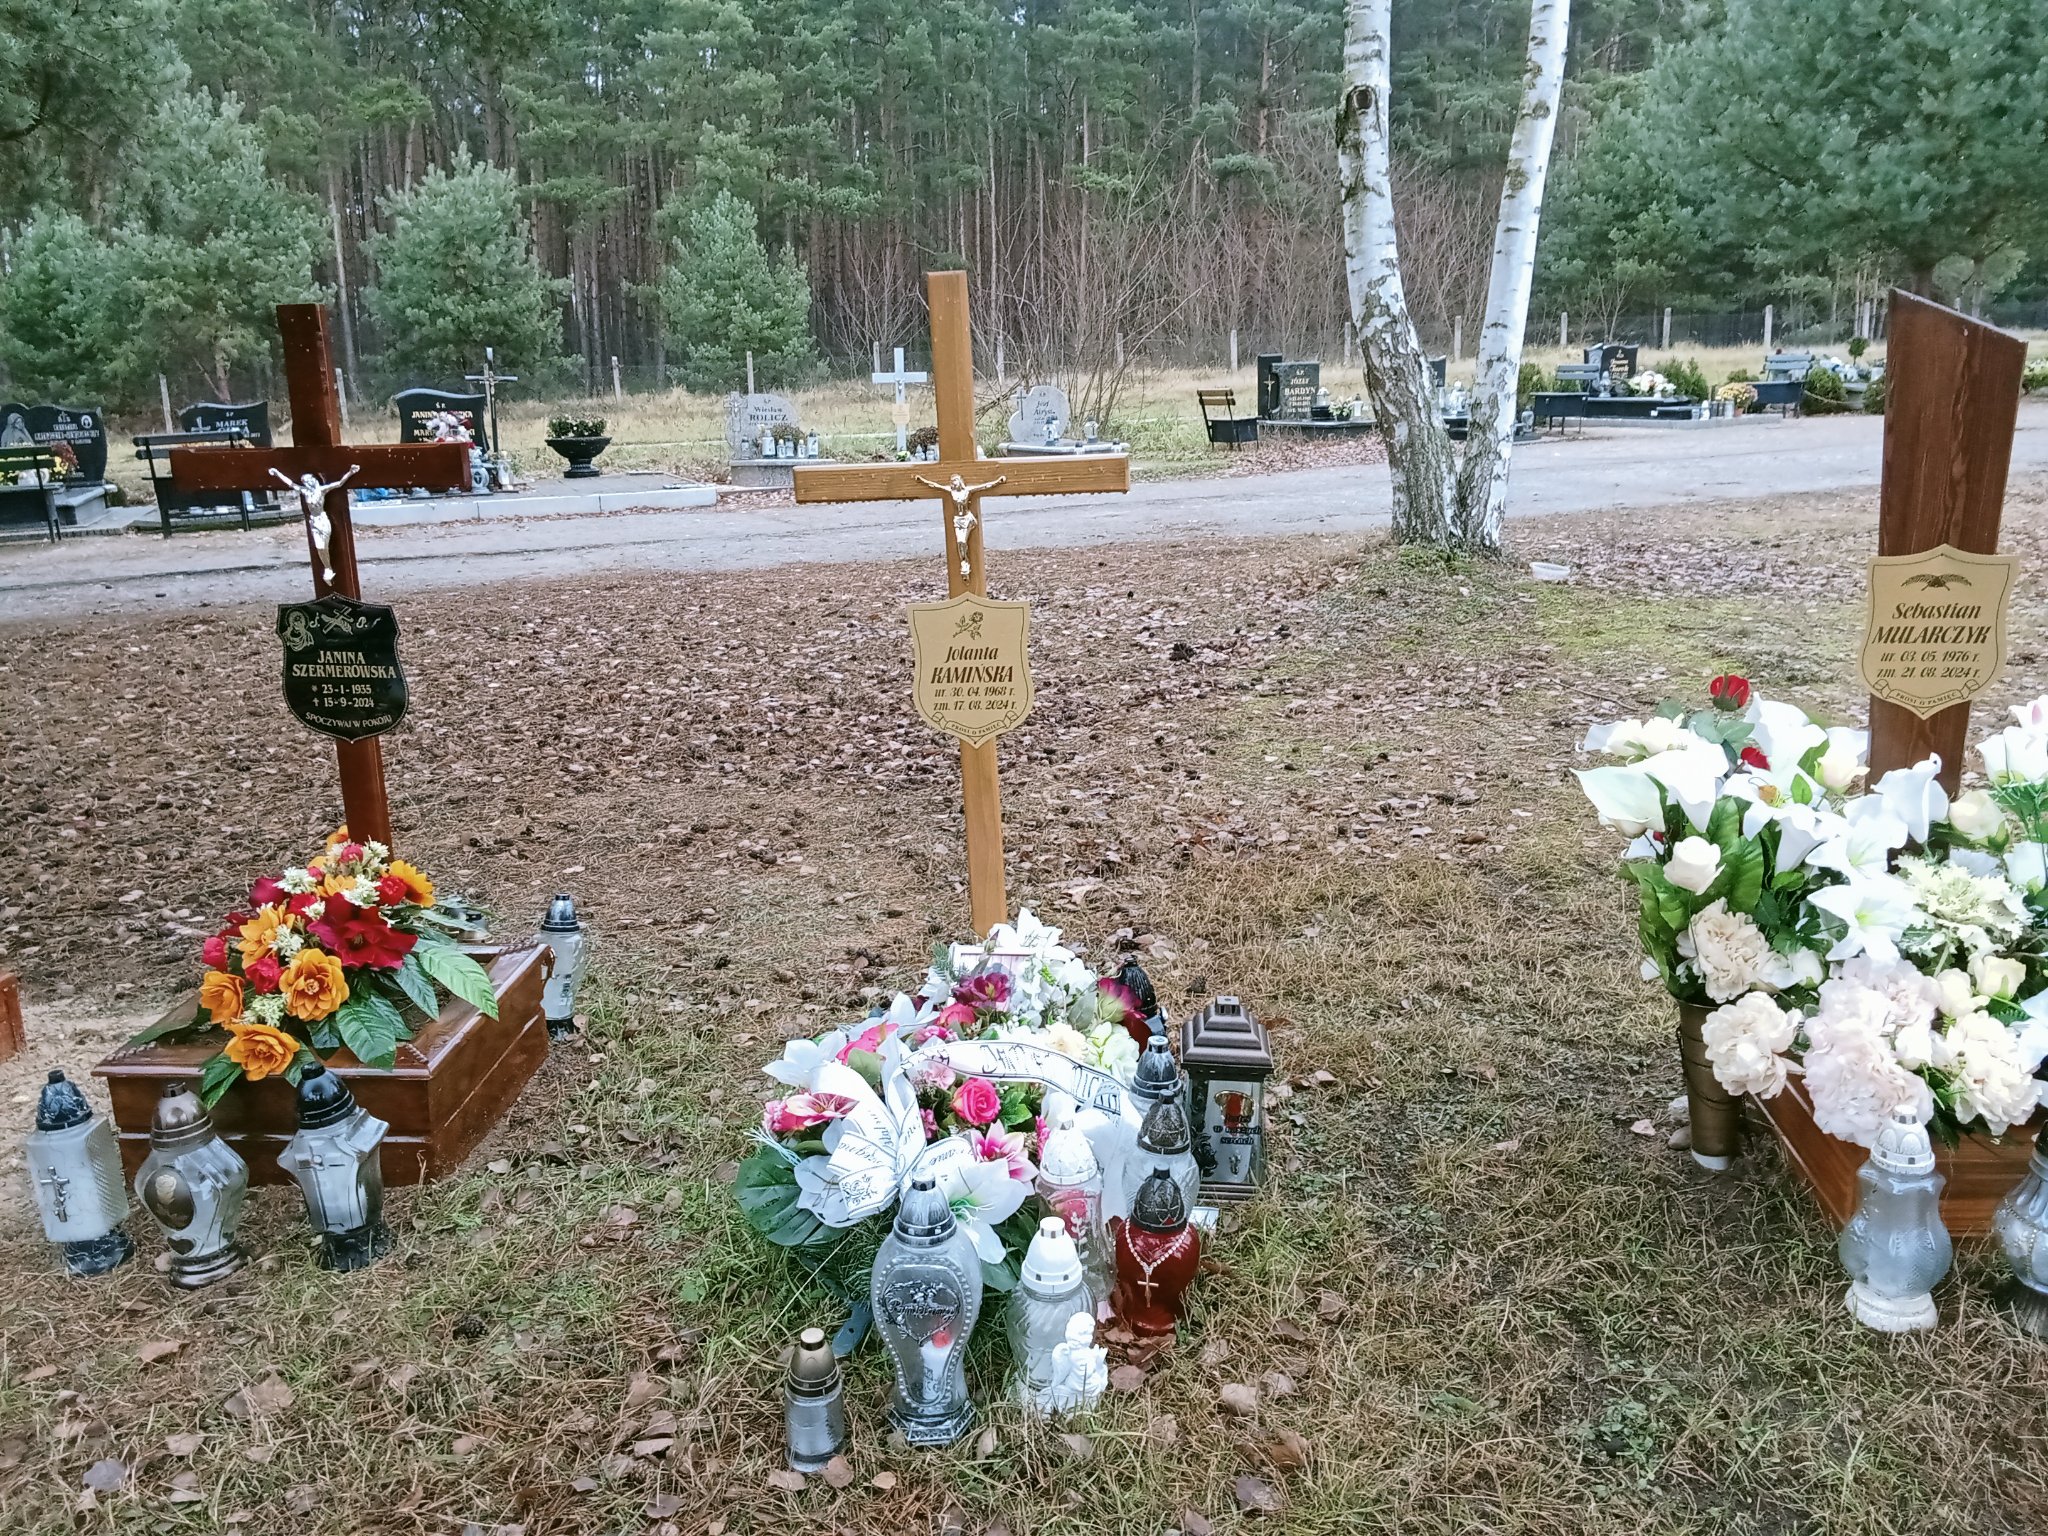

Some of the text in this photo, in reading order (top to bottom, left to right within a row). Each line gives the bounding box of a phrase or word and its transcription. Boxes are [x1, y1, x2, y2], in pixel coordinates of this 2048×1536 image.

[1284, 386, 1317, 396] BARDYN
[215, 419, 249, 428] MAREK
[1892, 602, 1982, 620] Sebastian
[1871, 625, 1992, 644] MULARCZYK
[317, 650, 366, 665] JANINA
[944, 646, 999, 663] Jolanta
[1941, 650, 1970, 662] 1976
[292, 663, 397, 679] SZERMEROWSKA
[930, 663, 1014, 684] KAMIŃSKA
[1941, 667, 1971, 678] 2024
[984, 686, 1007, 696] 1968
[985, 699, 1009, 710] 2024
[305, 711, 393, 728] SPOCZYWAJ W POKOJU
